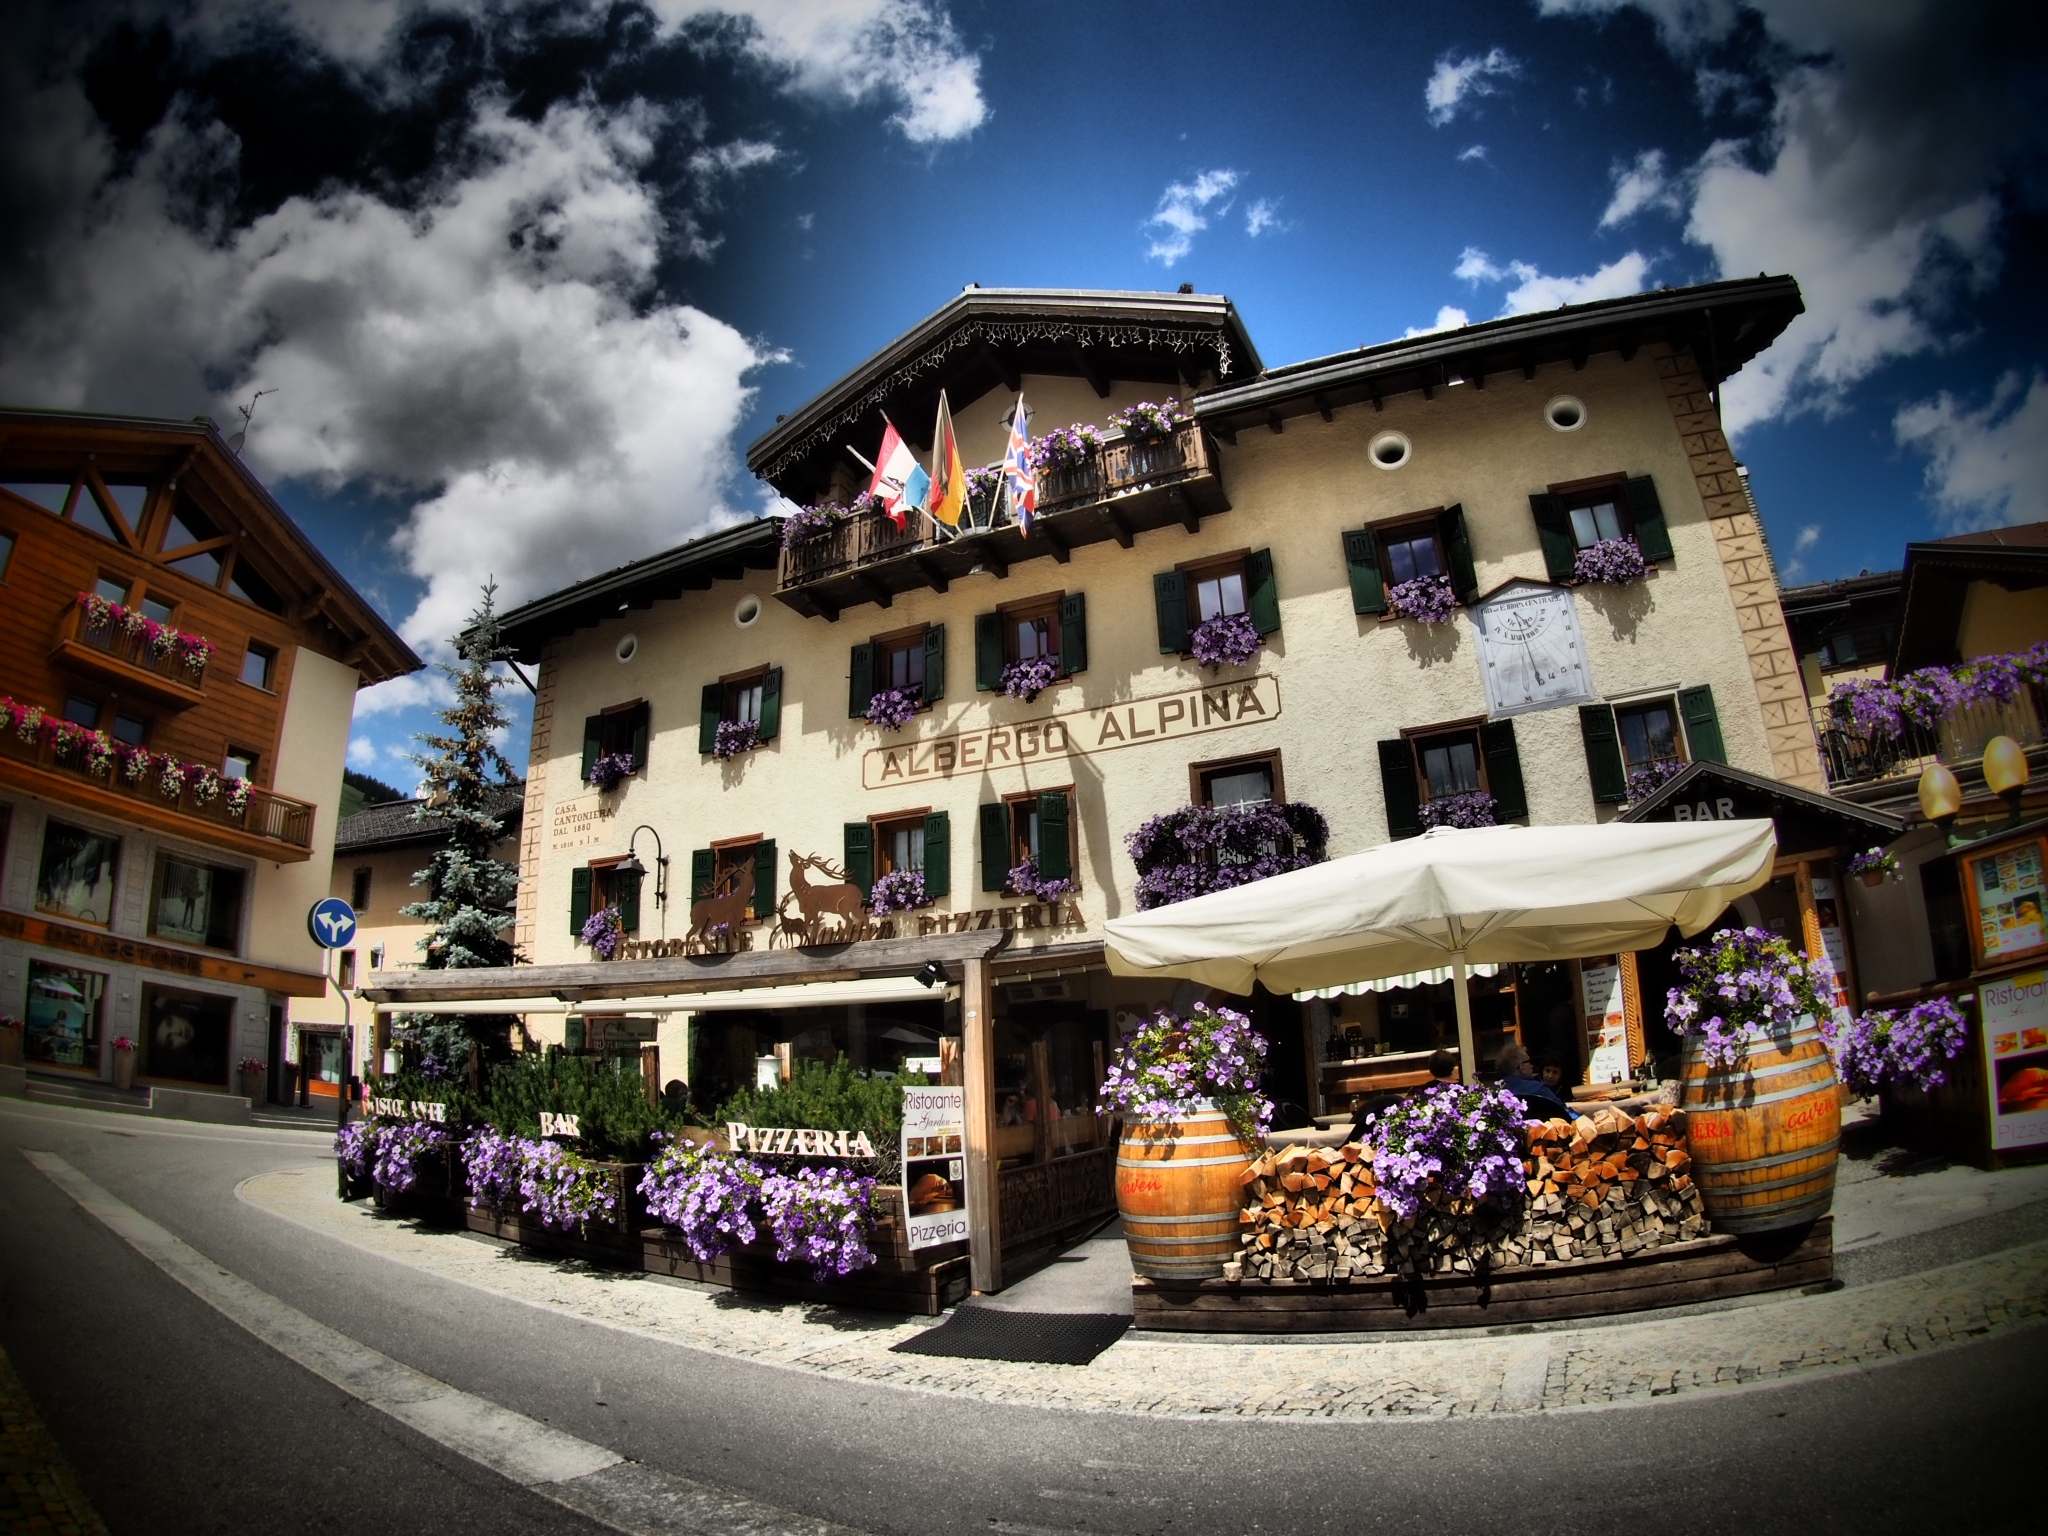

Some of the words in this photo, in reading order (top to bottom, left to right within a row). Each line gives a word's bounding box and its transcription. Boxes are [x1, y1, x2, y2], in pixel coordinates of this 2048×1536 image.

[880, 720, 1069, 781] ALBERGO
[1097, 684, 1266, 745] ALPINA
[554, 808, 613, 826] CANTONIERA
[555, 803, 577, 815] CASA
[1673, 797, 1736, 822] BAR
[553, 827, 568, 837] DAL
[573, 822, 591, 833] 1880
[916, 900, 1086, 936] PIZZERIA
[45, 925, 204, 973] DRUGSTORE
[905, 1092, 961, 1110] Ristorante
[539, 1112, 581, 1138] BAR
[919, 1110, 950, 1131] Garden
[1787, 1098, 1834, 1130] caven
[726, 1121, 877, 1158] PIZZERIA
[910, 1219, 966, 1243] Pizzeria
